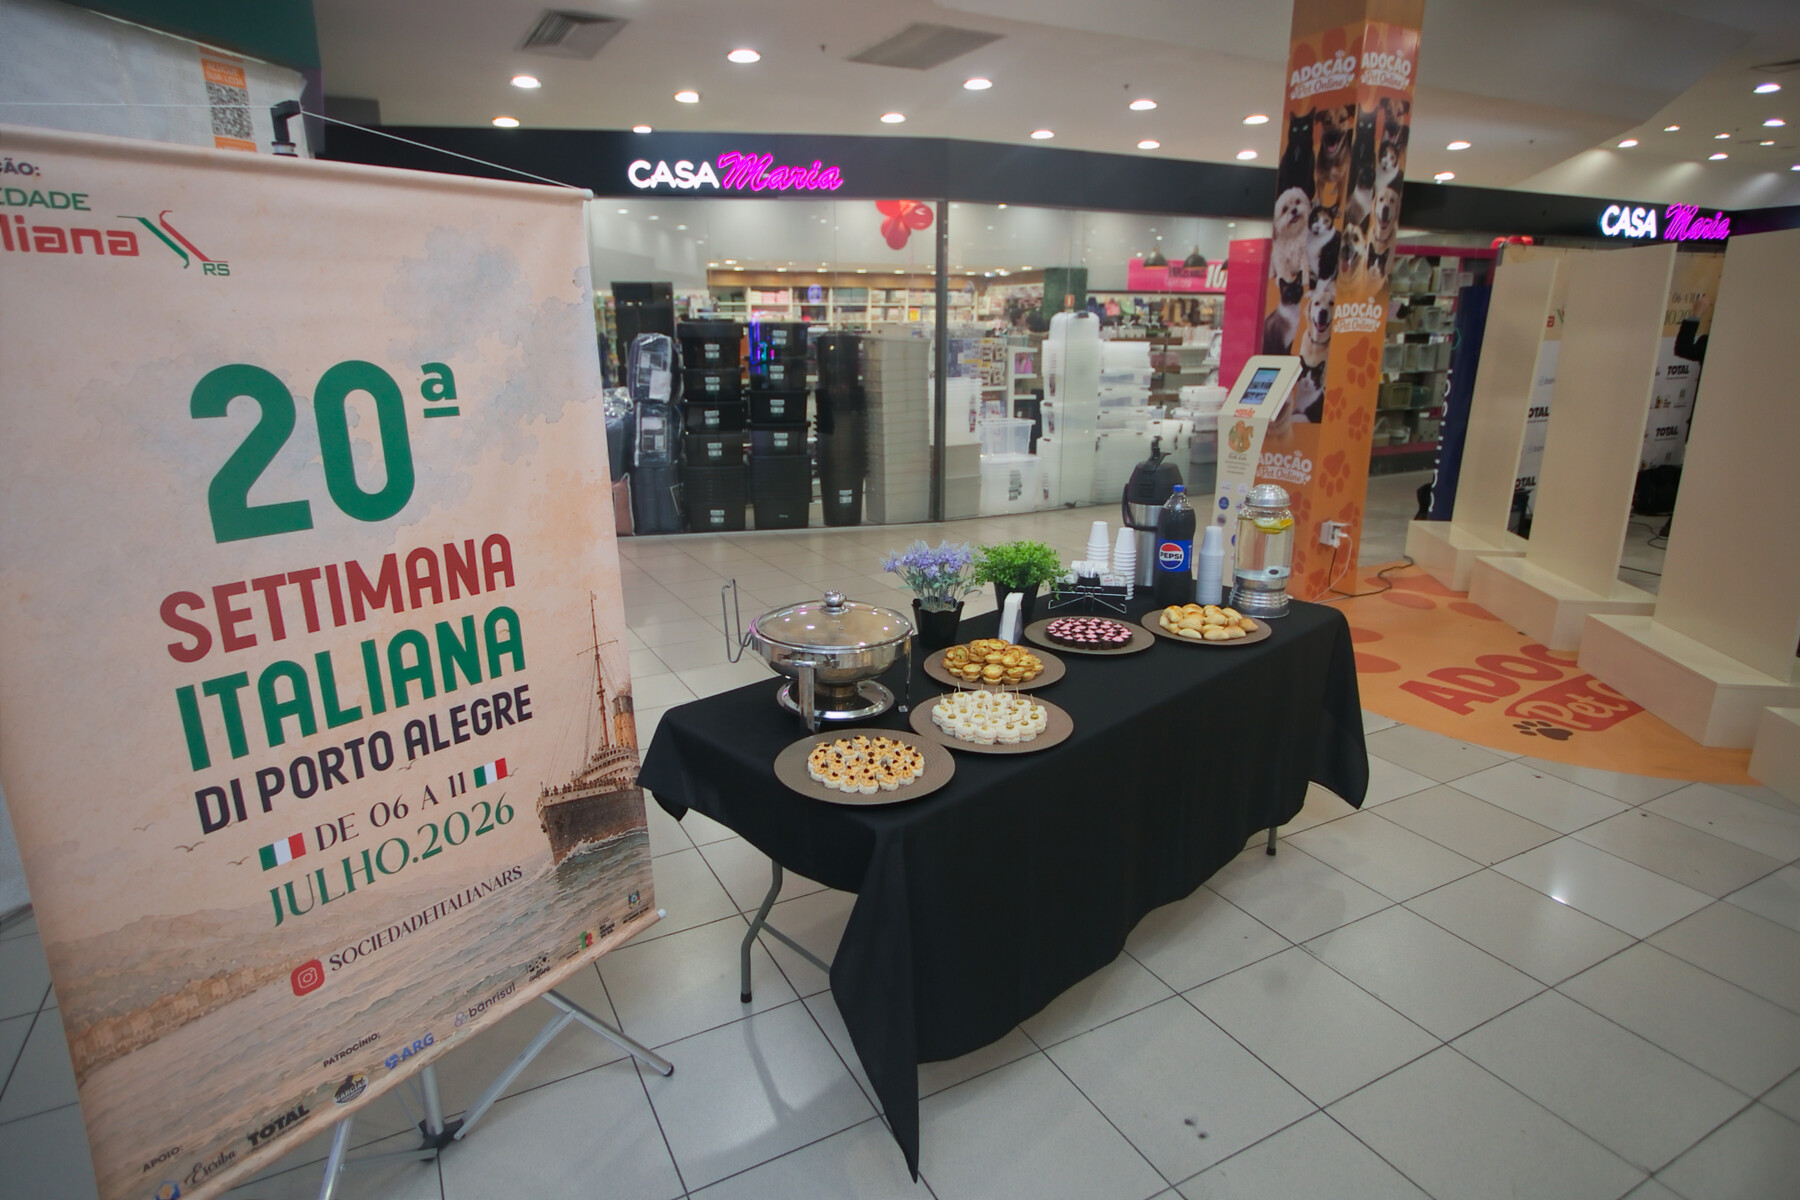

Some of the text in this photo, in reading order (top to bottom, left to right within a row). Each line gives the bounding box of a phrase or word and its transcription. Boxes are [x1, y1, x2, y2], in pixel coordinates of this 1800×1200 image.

[1290, 50, 1356, 87] ADOÇÃO
[1361, 50, 1411, 76] ADOÇÃO
[628, 151, 843, 192] CASA Maria
[1599, 202, 1730, 242] CASA Maria
[203, 262, 230, 276] RS
[1334, 297, 1382, 320] ADOÇÃO
[1667, 365, 1689, 375] TOTAL
[1656, 426, 1678, 437] TOTAL
[190, 359, 461, 544] 20ª
[1262, 467, 1301, 482] Pet Online
[1160, 551, 1183, 560] PEPSI
[160, 533, 516, 663] SETTIMANA
[176, 606, 526, 772] ITALIANA
[1515, 693, 1628, 729] Pet
[195, 684, 533, 835] DI PORTO ALEGRE
[315, 812, 360, 851] DE
[370, 794, 409, 828] 06
[421, 785, 439, 810] A
[269, 792, 515, 928] JULHO.2026
[329, 865, 523, 972] SOCIEDADEITALIANARS
[467, 982, 516, 1018] banrisul
[322, 1032, 381, 1068] PATROCÍNIO:
[401, 1032, 434, 1062] ARG
[247, 1104, 310, 1146] TOTAL
[142, 1145, 183, 1173] APOIO:
[185, 1151, 237, 1185] Escriba
